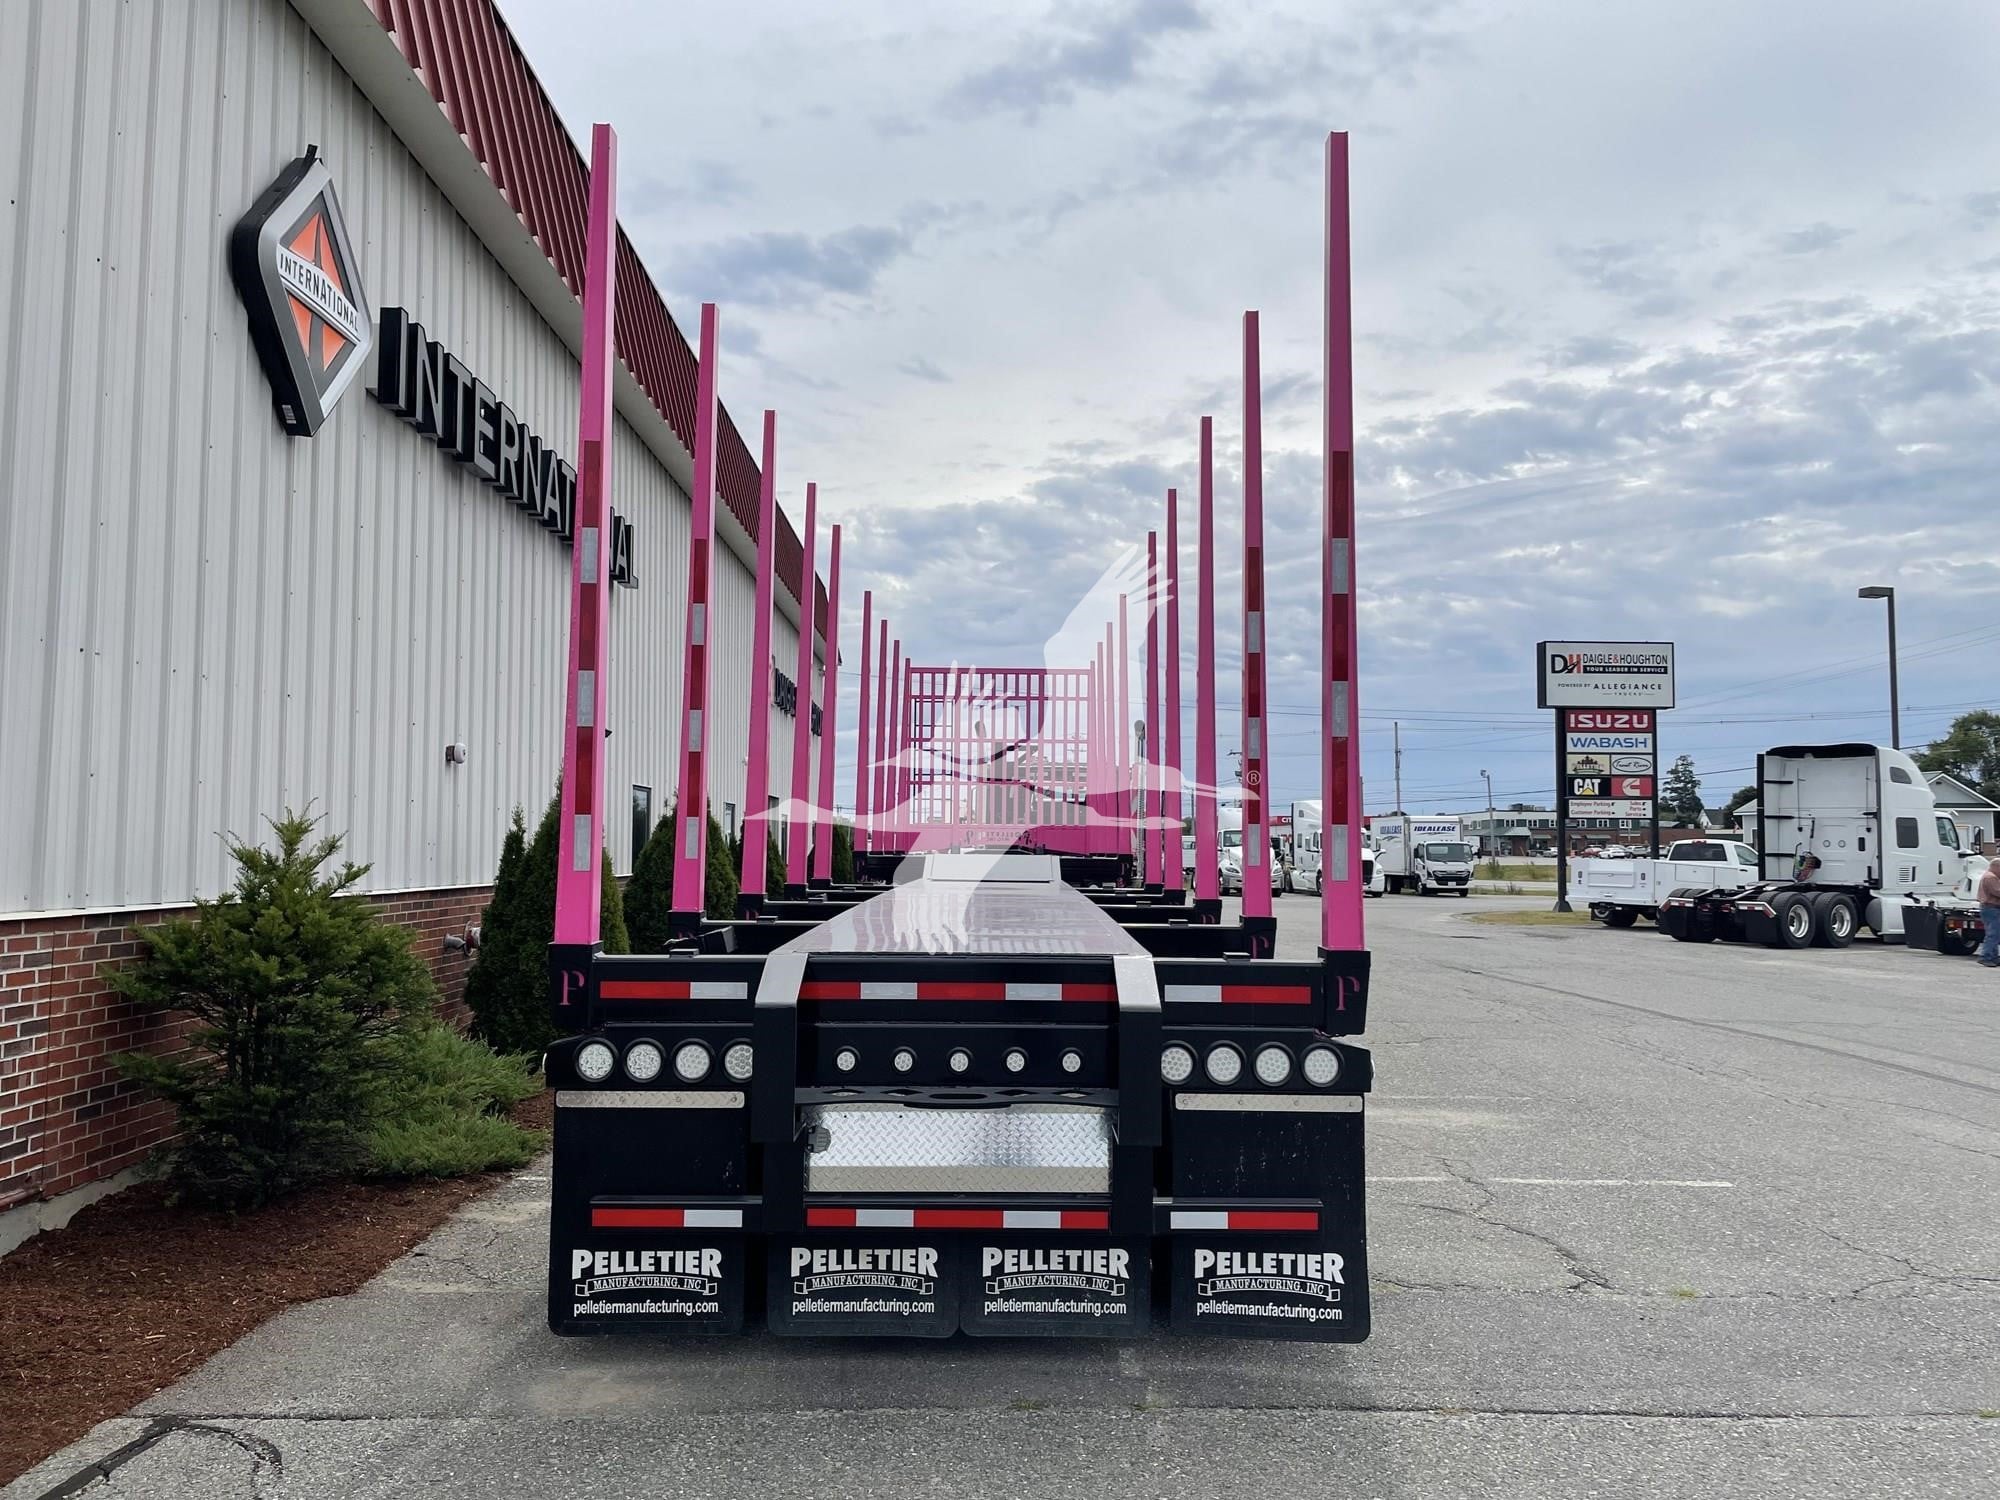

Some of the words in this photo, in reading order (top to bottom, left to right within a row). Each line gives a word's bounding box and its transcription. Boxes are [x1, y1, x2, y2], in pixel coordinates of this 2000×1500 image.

[280, 253, 358, 332] INTERNATIONAL
[377, 307, 639, 589] INTERNATAL
[1583, 654, 1668, 665] DAIGLE&HOUGHTON
[1569, 713, 1648, 728] ISUZU
[1570, 737, 1648, 748] WABASH
[1573, 778, 1601, 796] CAT
[572, 1248, 723, 1280] PELLETIER
[790, 1247, 939, 1278] PELLETIER
[982, 1247, 1130, 1279] PELLETIER
[1194, 1249, 1345, 1285] PELLETIER
[593, 1276, 681, 1290] MANUFACTURING,
[811, 1274, 898, 1288] MANUFACTURING,
[1003, 1275, 1089, 1288] MANUFACTURING,
[1215, 1278, 1303, 1292] MANUFACTURING,
[573, 1299, 719, 1317] pelletiermanufacturing.com
[792, 1298, 935, 1316] pelletiermanufacturing.com
[984, 1298, 1127, 1317] pelletiermanufacturing.com
[1196, 1299, 1343, 1322] pelletiermanufacturing.com
